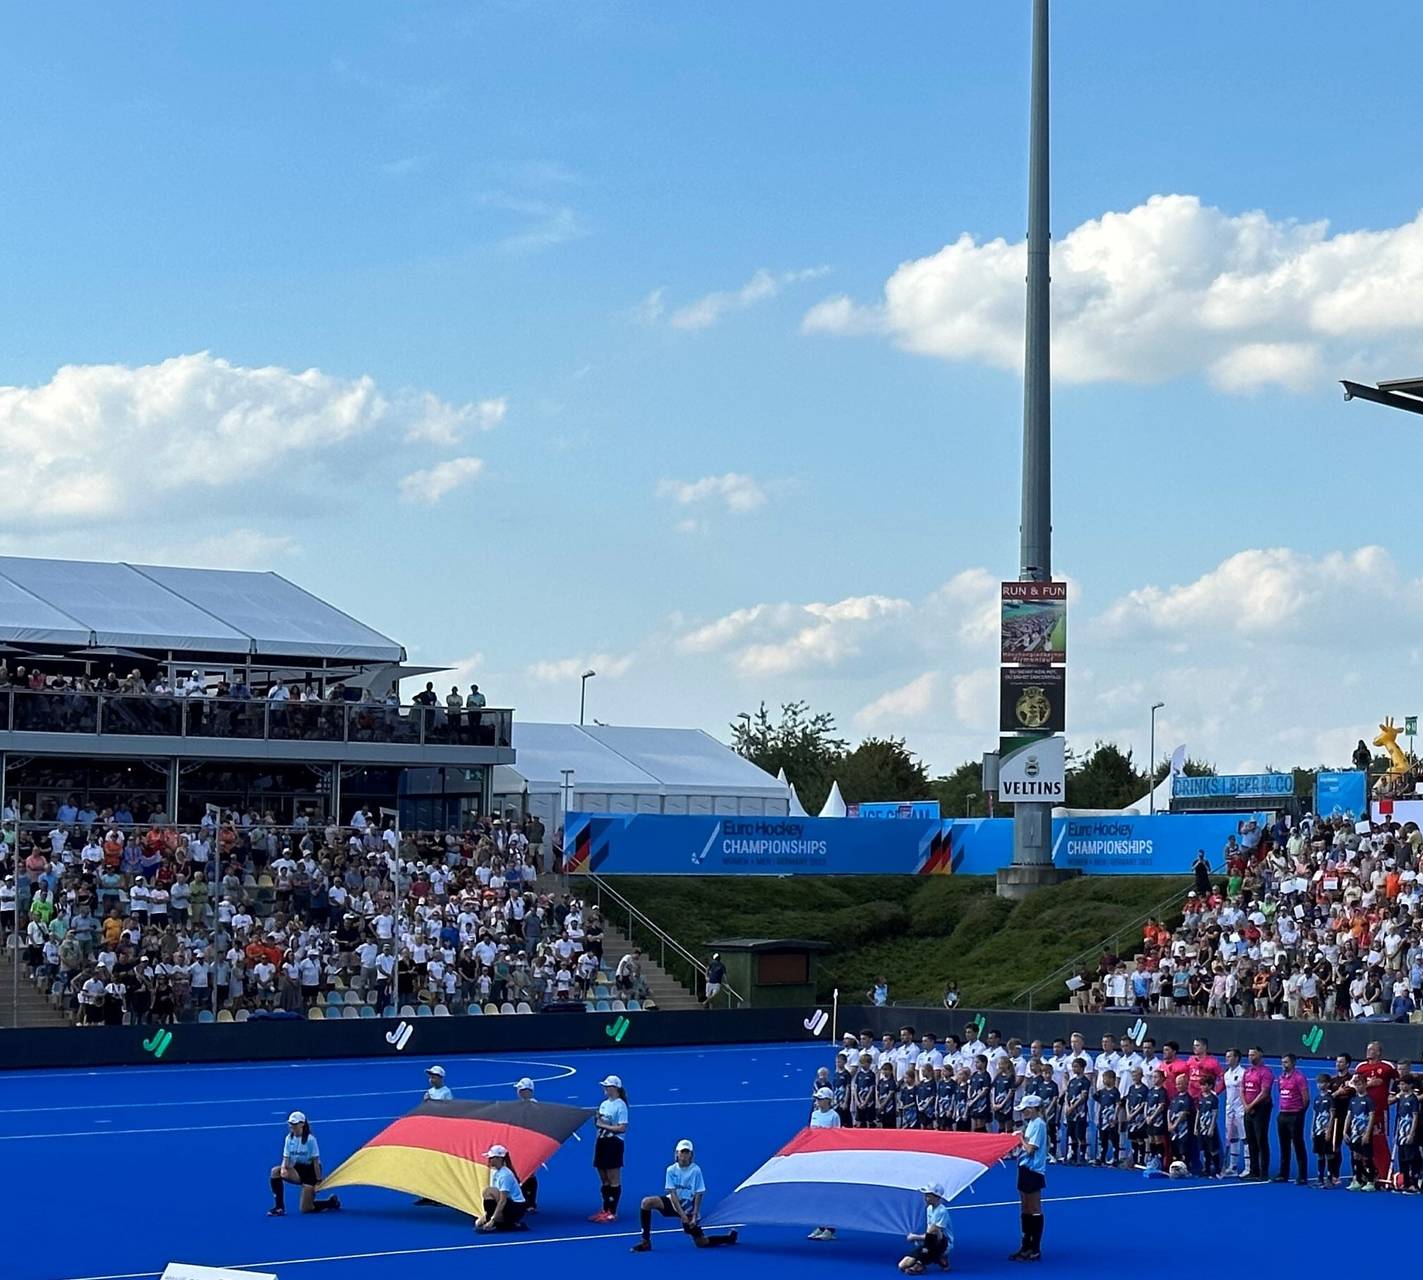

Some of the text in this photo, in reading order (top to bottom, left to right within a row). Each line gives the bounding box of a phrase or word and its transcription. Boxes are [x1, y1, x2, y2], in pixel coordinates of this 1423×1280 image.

[1002, 586, 1065, 596] RUN & FUN
[1003, 781, 1062, 795] VELTINS
[1175, 778, 1218, 795] DRINKS
[1276, 775, 1293, 792] CO
[723, 820, 805, 838] Euro Hockey
[1068, 820, 1134, 839] Euro Hockey
[722, 839, 827, 855] CHAMPIONSHIPS
[1067, 839, 1153, 855] CHAMPIONSHIPS
